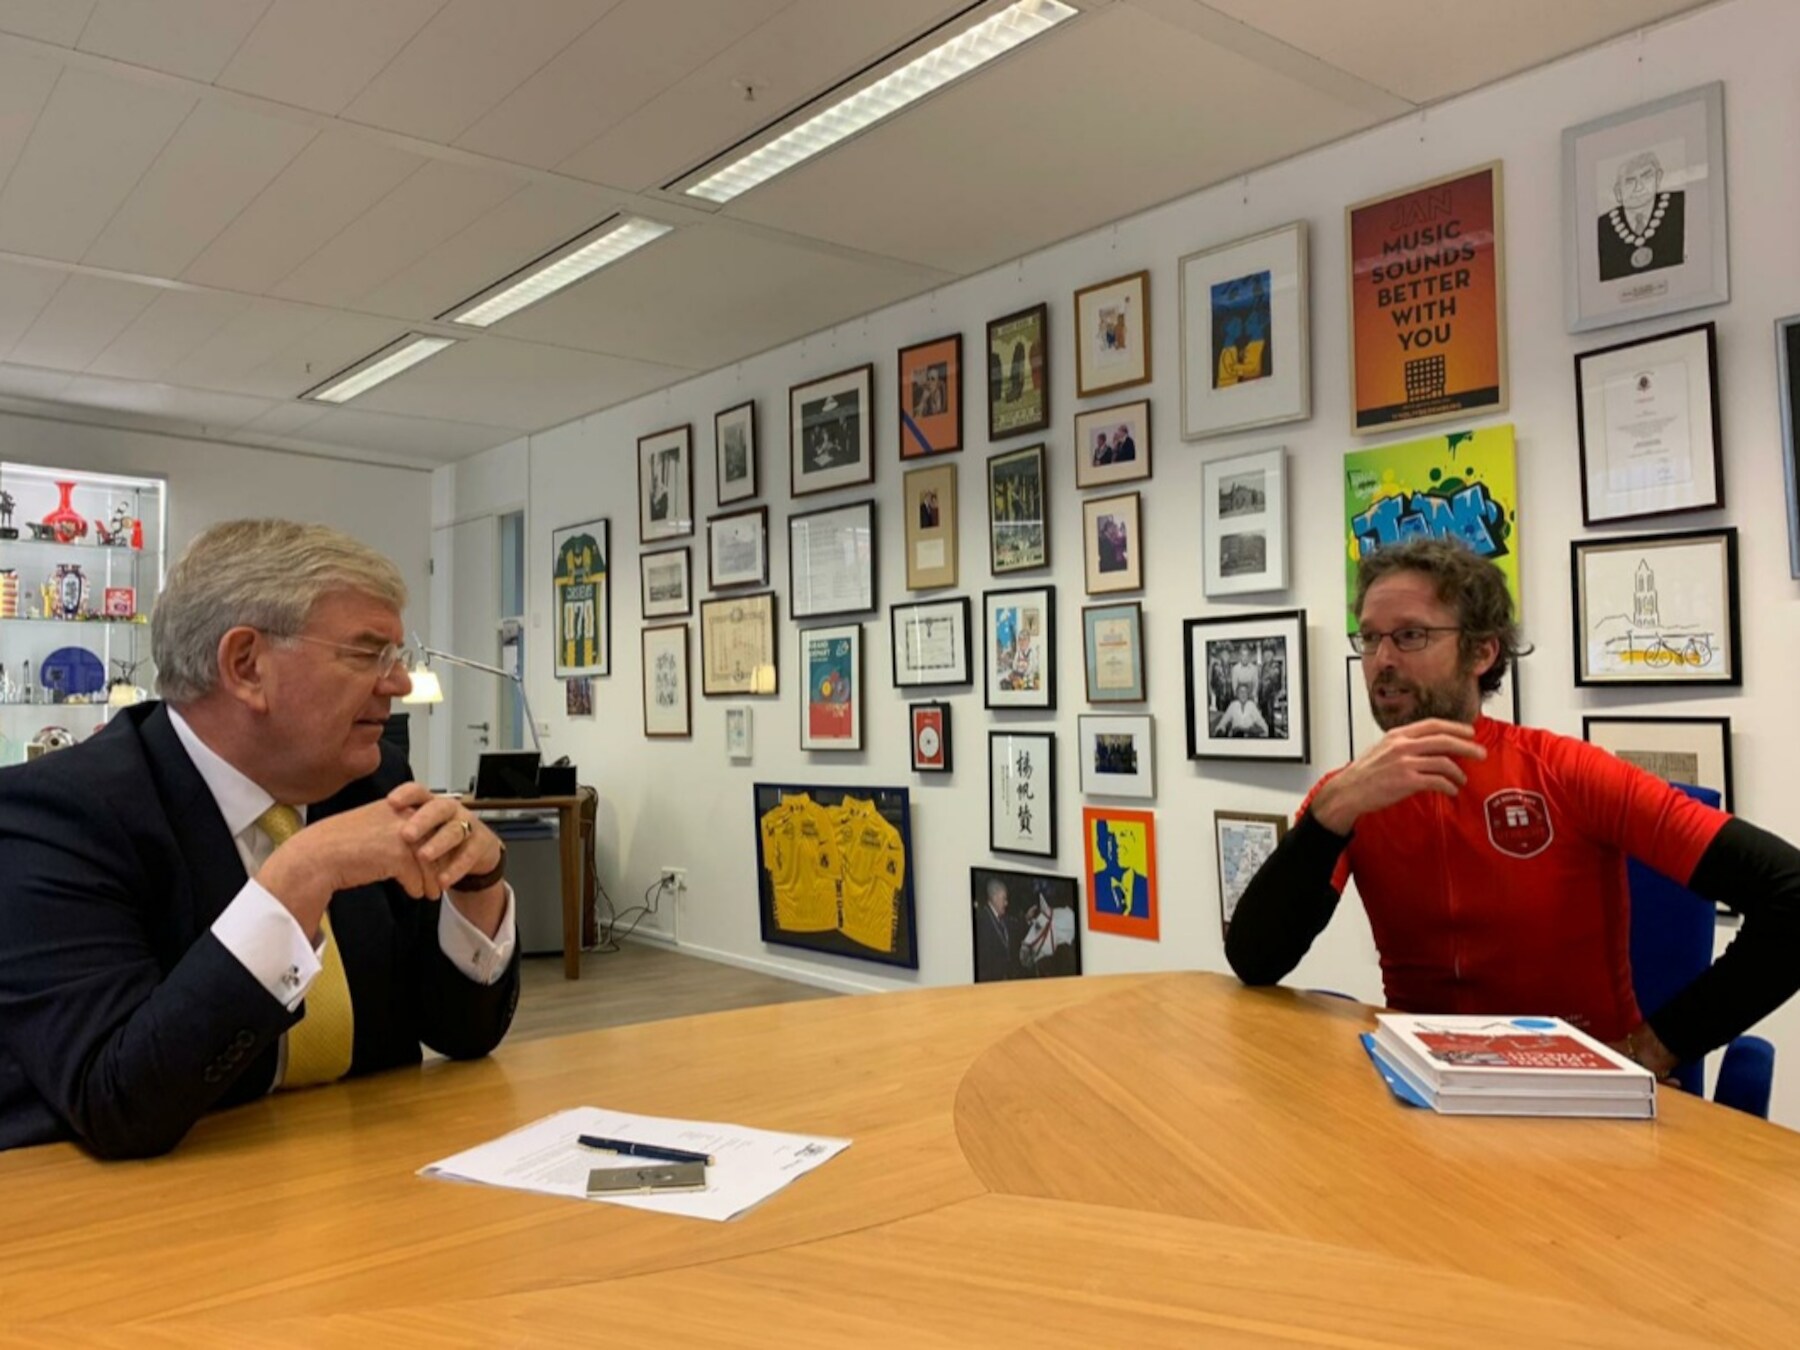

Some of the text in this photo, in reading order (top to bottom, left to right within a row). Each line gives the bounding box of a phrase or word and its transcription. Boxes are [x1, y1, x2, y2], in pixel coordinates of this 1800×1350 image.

[1390, 188, 1452, 232] JAN
[1382, 220, 1461, 256] MUSIC
[1371, 242, 1476, 284] SOUNDS
[1377, 269, 1471, 308] BETTER
[1391, 297, 1457, 327] WITH
[1397, 323, 1451, 351] YOU
